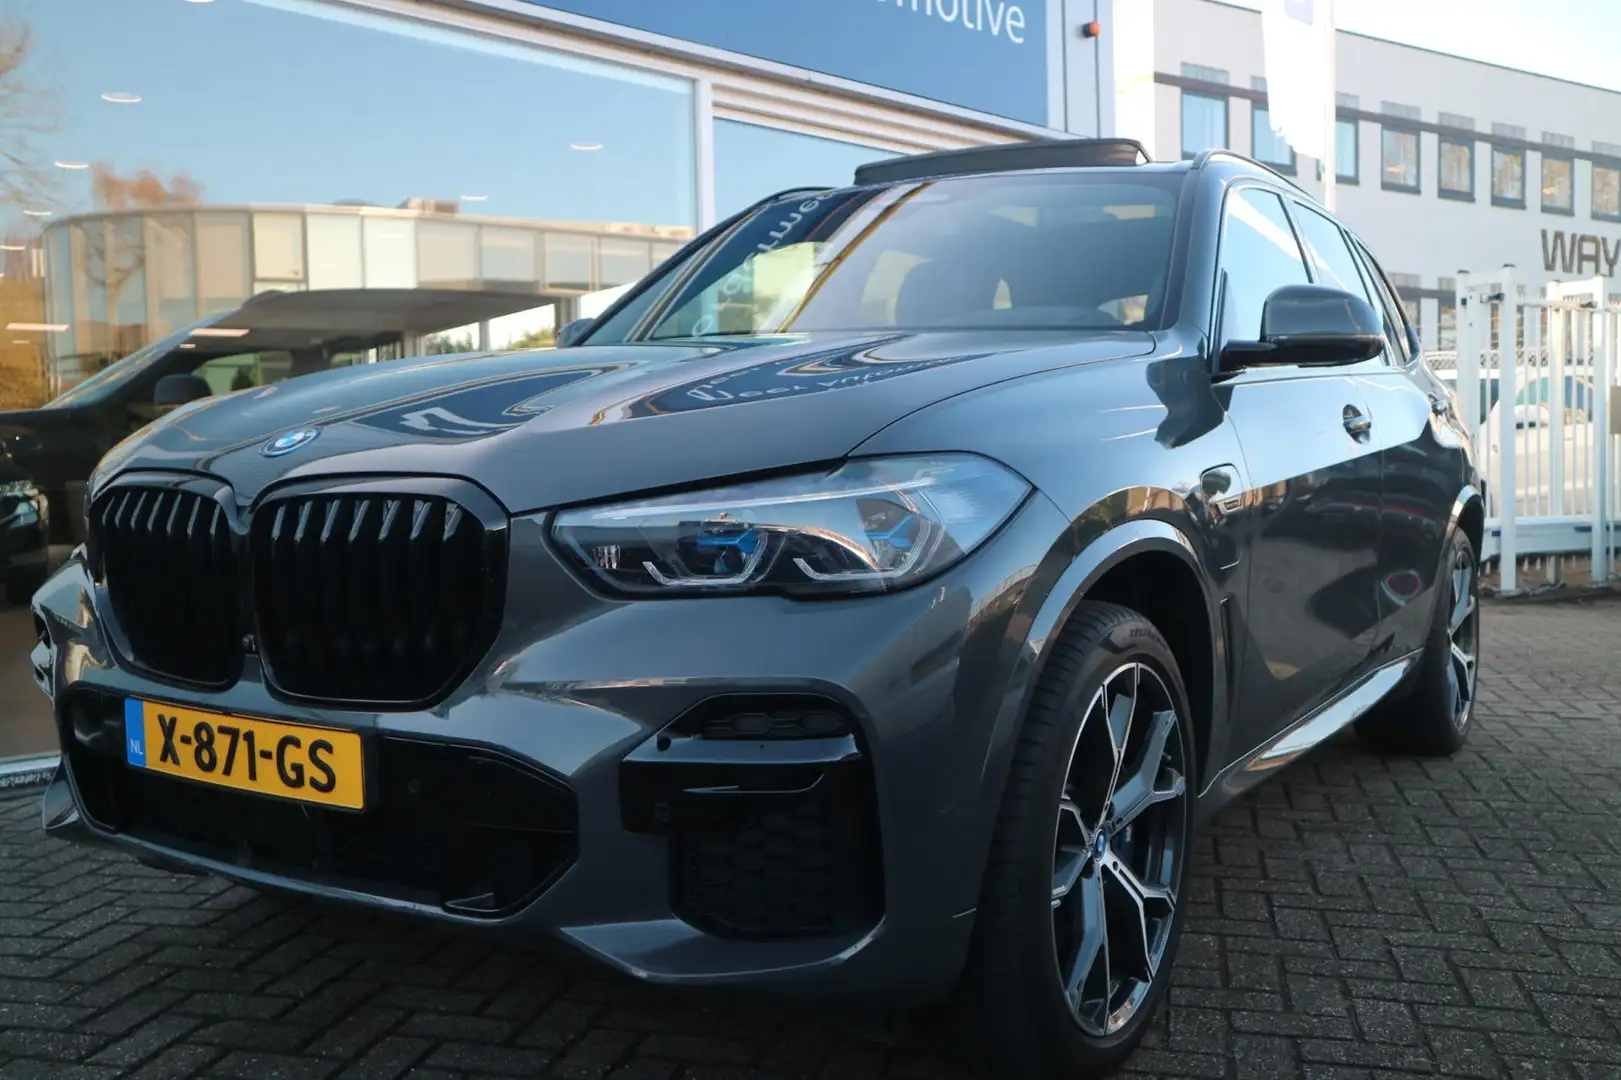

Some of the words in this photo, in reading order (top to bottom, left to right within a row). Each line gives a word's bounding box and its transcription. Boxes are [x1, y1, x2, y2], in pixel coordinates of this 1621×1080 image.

[877, 0, 1025, 44] otive
[1541, 228, 1621, 278] WAY
[130, 739, 144, 756] NL
[157, 713, 336, 793] X-871-GS
